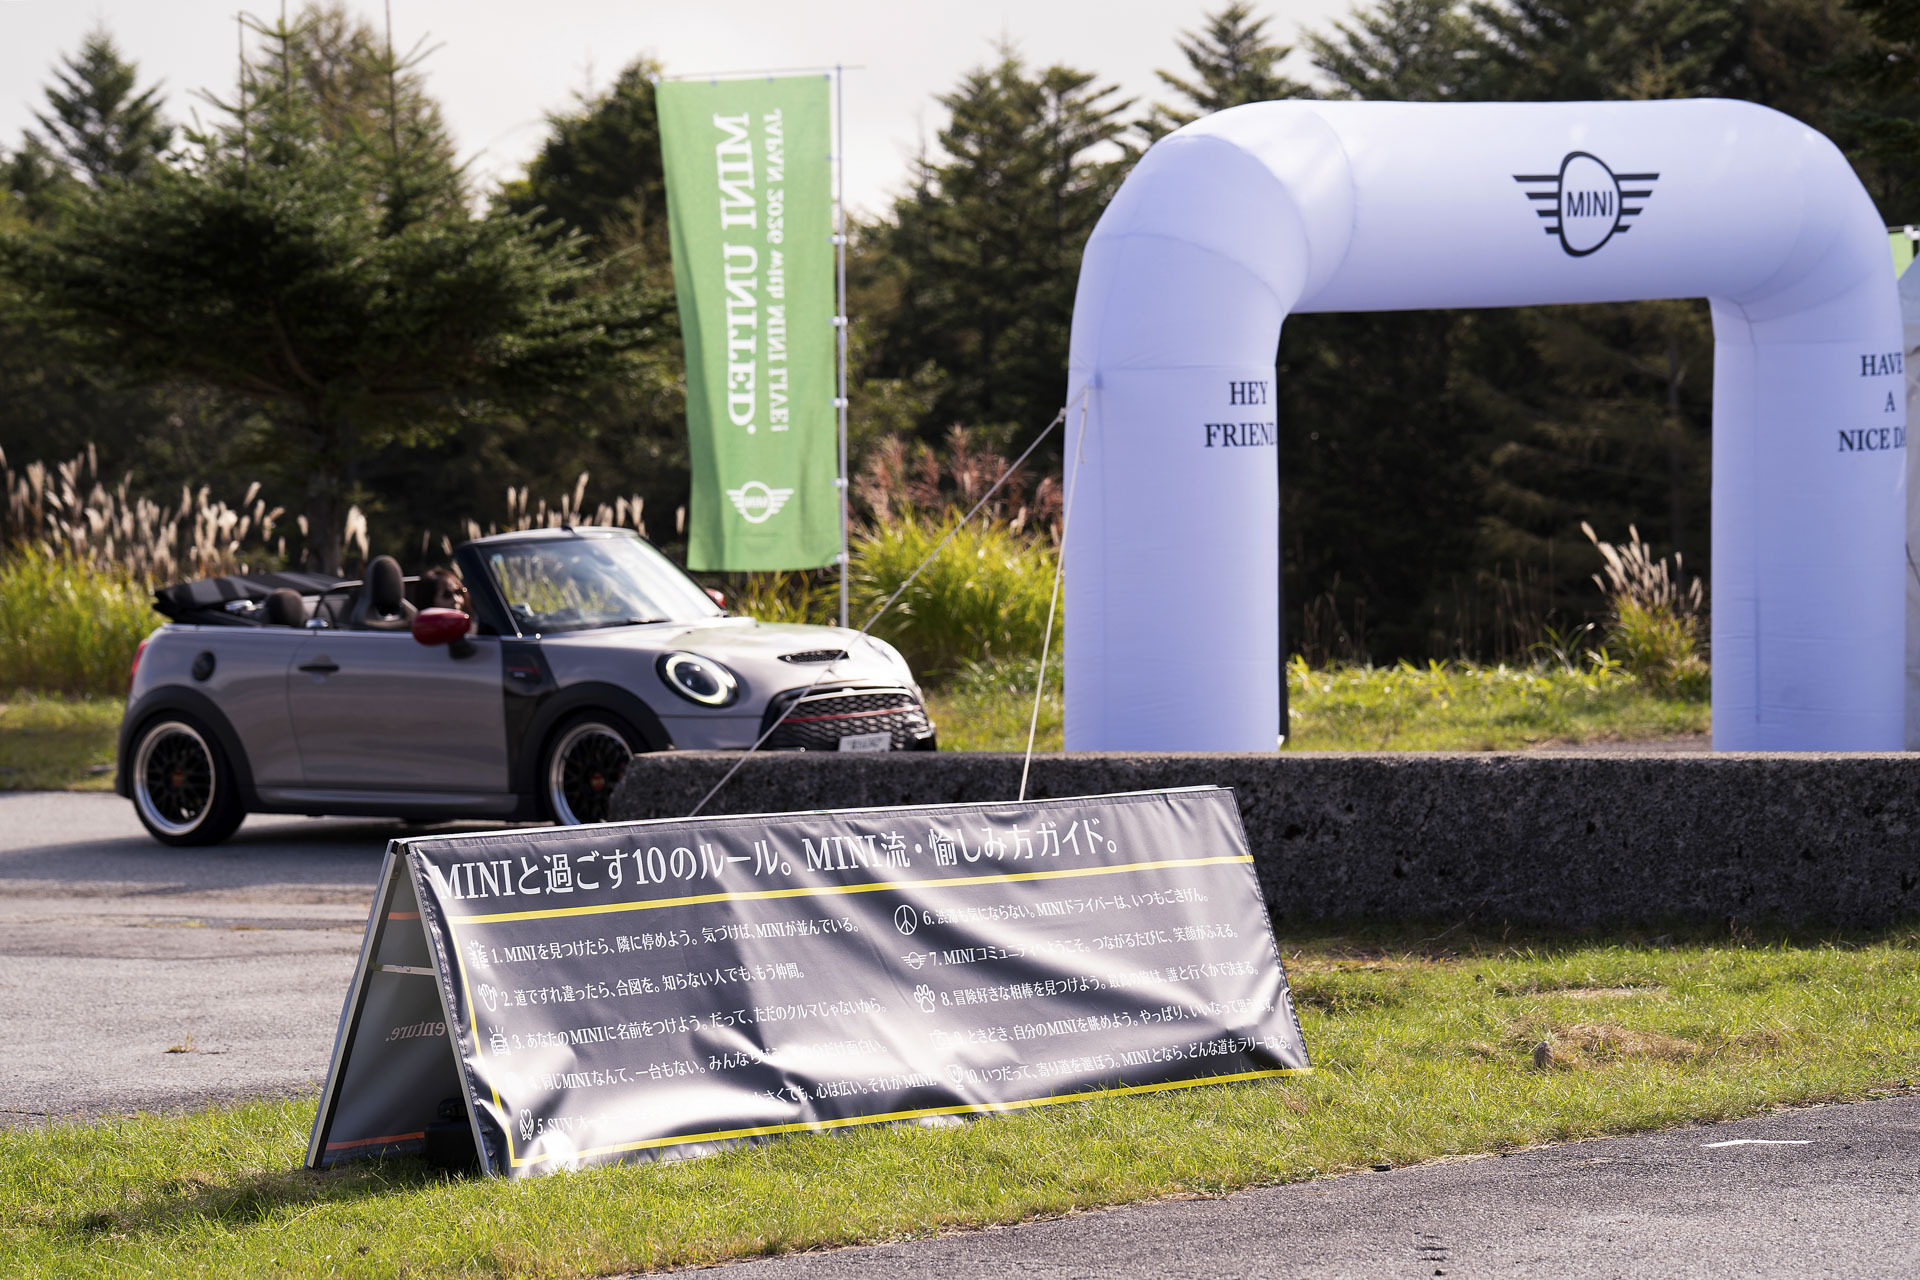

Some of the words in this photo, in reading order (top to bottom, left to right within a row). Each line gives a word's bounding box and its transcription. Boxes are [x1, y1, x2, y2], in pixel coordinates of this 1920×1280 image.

[1566, 190, 1614, 218] MINI
[1229, 380, 1268, 406] HEY
[1883, 389, 1896, 413] A
[1203, 421, 1277, 448] FRIEN
[1837, 426, 1891, 453] NICE
